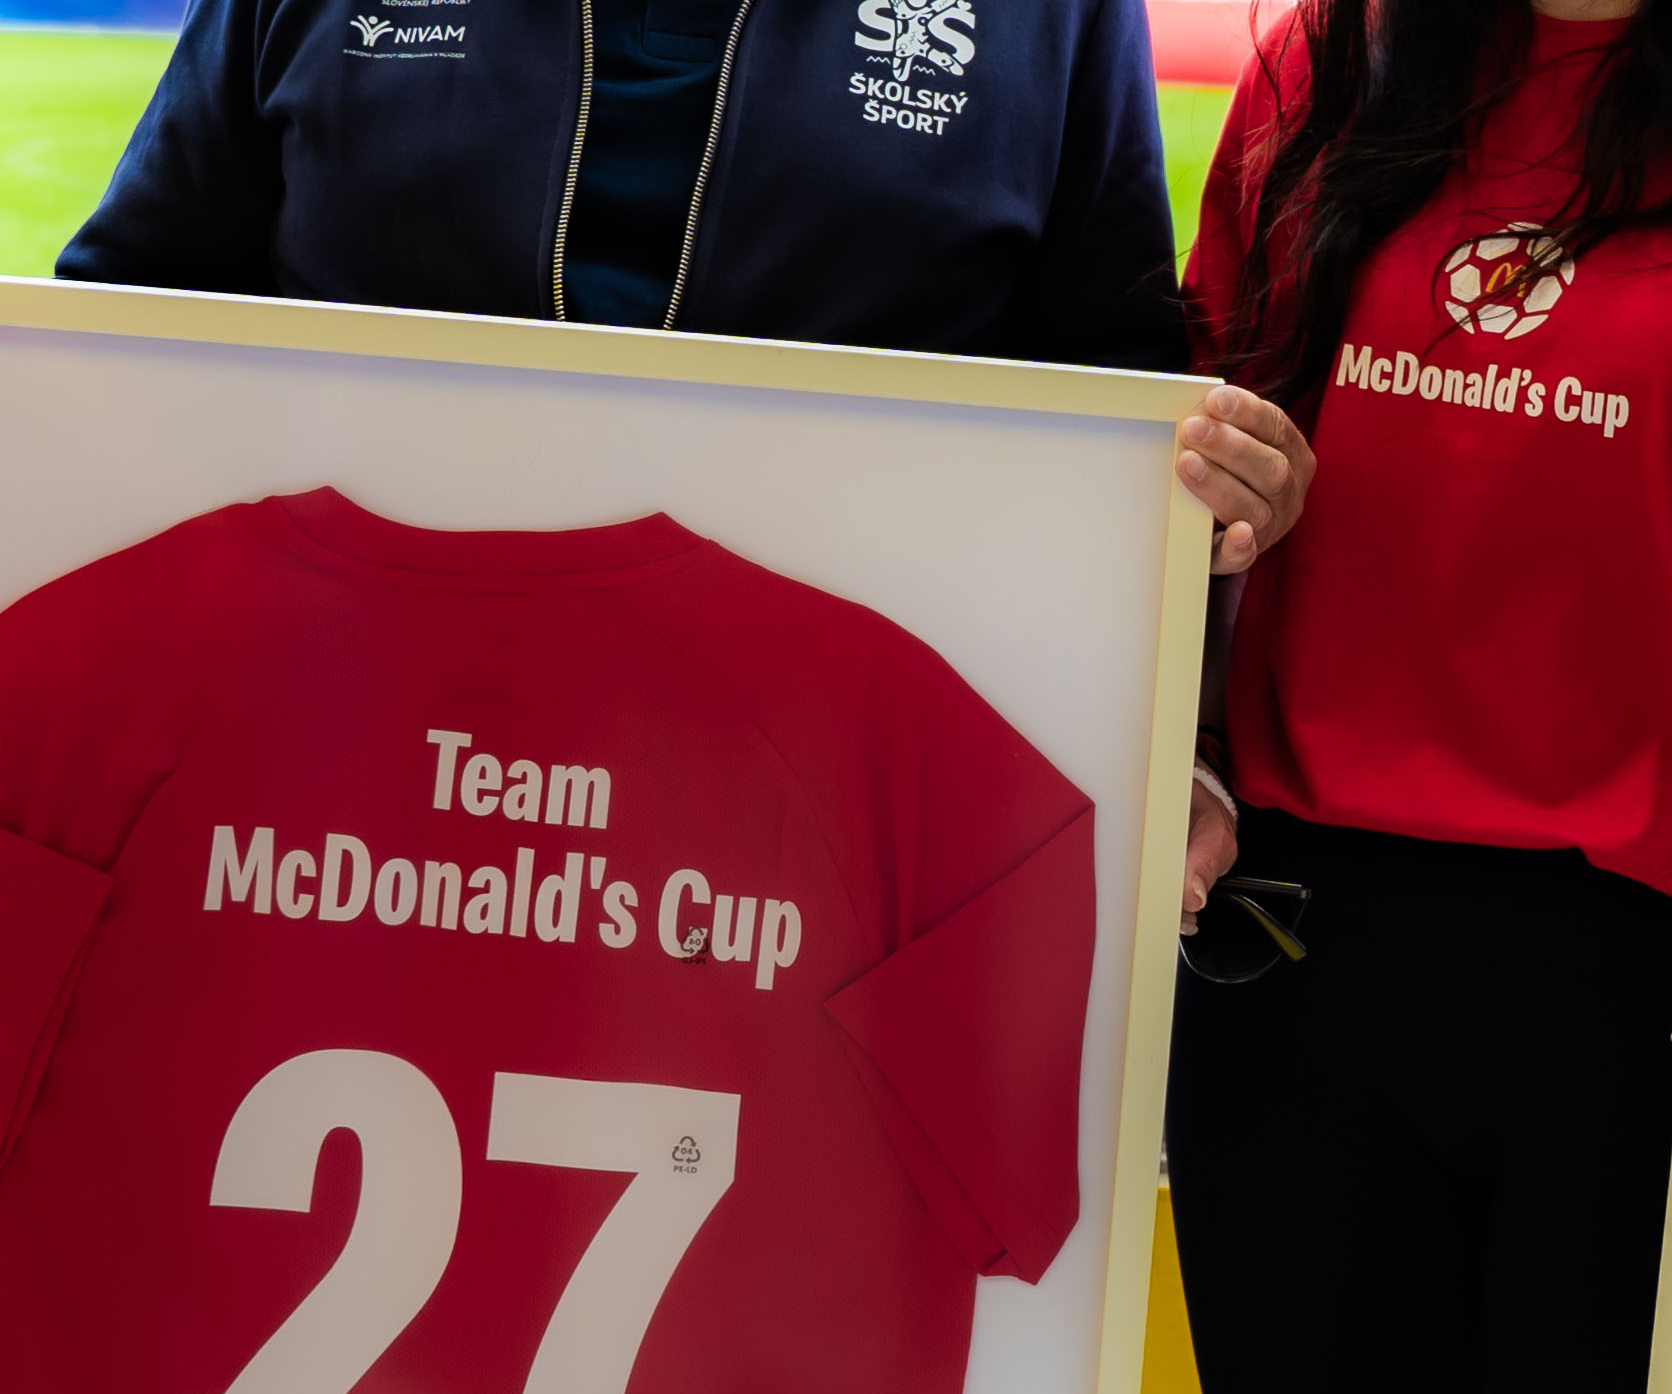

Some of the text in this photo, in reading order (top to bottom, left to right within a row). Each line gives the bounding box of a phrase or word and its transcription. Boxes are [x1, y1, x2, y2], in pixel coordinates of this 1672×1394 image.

[394, 24, 466, 44] NIVAM
[849, 71, 969, 114] ŠKOLSKÝ
[863, 98, 950, 135] ŠPORT
[1554, 376, 1630, 438] Cup
[427, 729, 612, 829] Team
[204, 826, 802, 990] McDonald's Cup
[673, 1165, 698, 1174] PE-LD
[680, 1147, 693, 1156] 04
